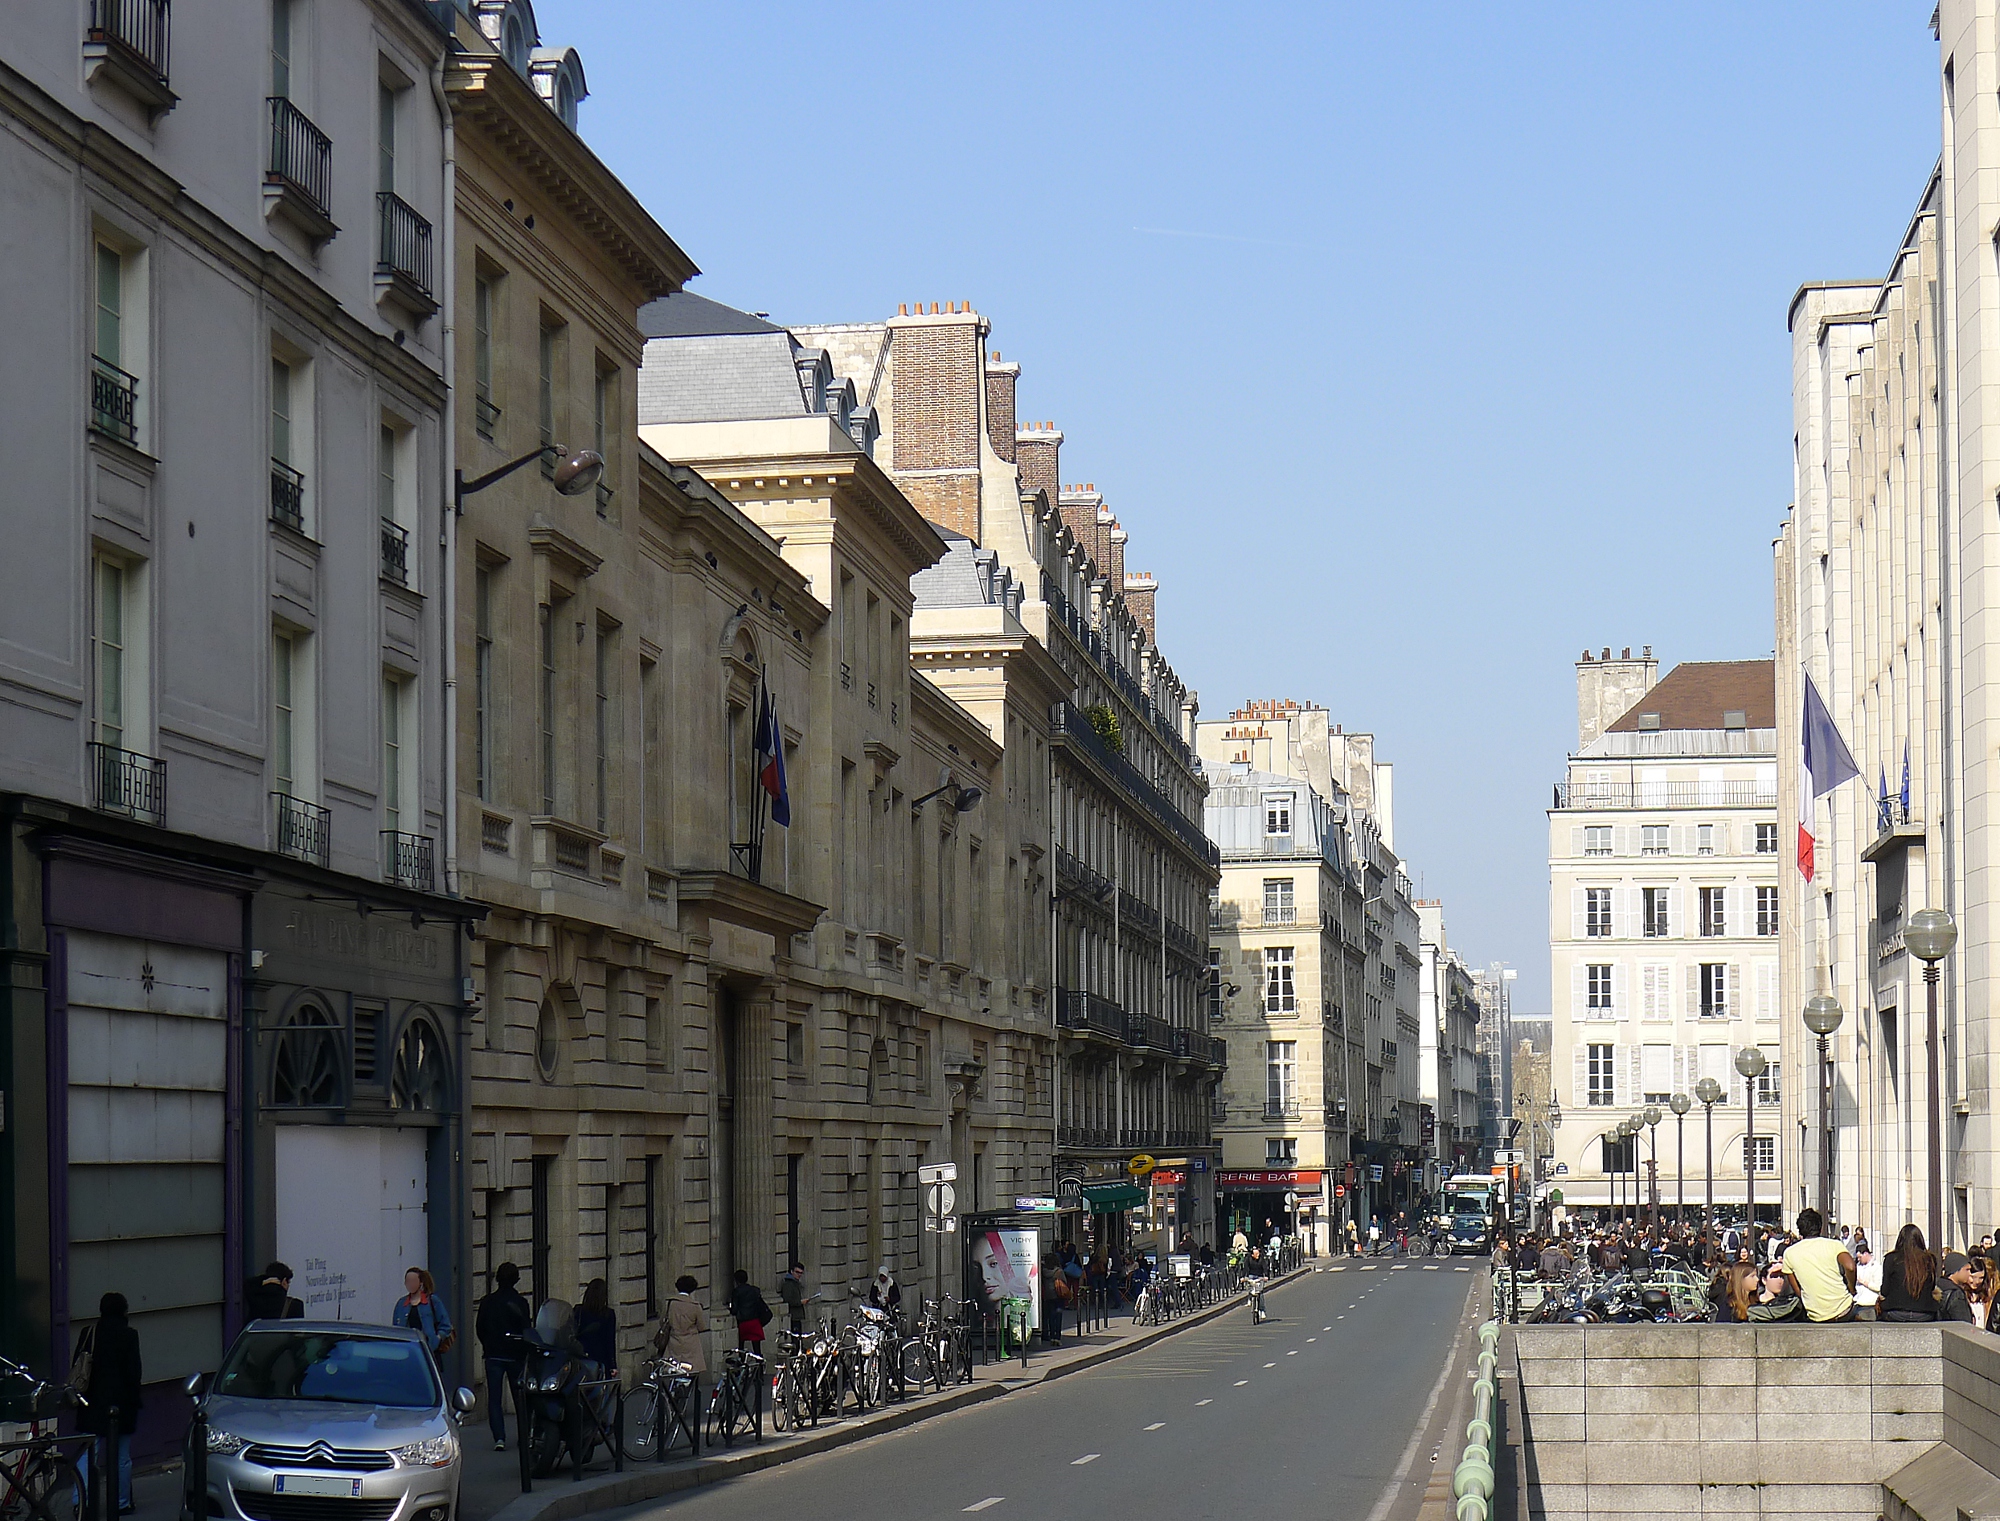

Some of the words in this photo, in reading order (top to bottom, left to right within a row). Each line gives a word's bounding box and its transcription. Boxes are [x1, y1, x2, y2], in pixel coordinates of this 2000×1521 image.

[291, 910, 318, 949] TAI
[328, 918, 368, 957] PING
[375, 925, 437, 969] CARPETS
[1214, 1173, 1262, 1181] SERIE
[1267, 1173, 1299, 1181] BAR
[305, 1258, 314, 1271] Tai
[314, 1257, 327, 1273] Ping
[305, 1273, 328, 1287] Nouvelle
[310, 1290, 325, 1307] partir
[326, 1289, 333, 1302] du
